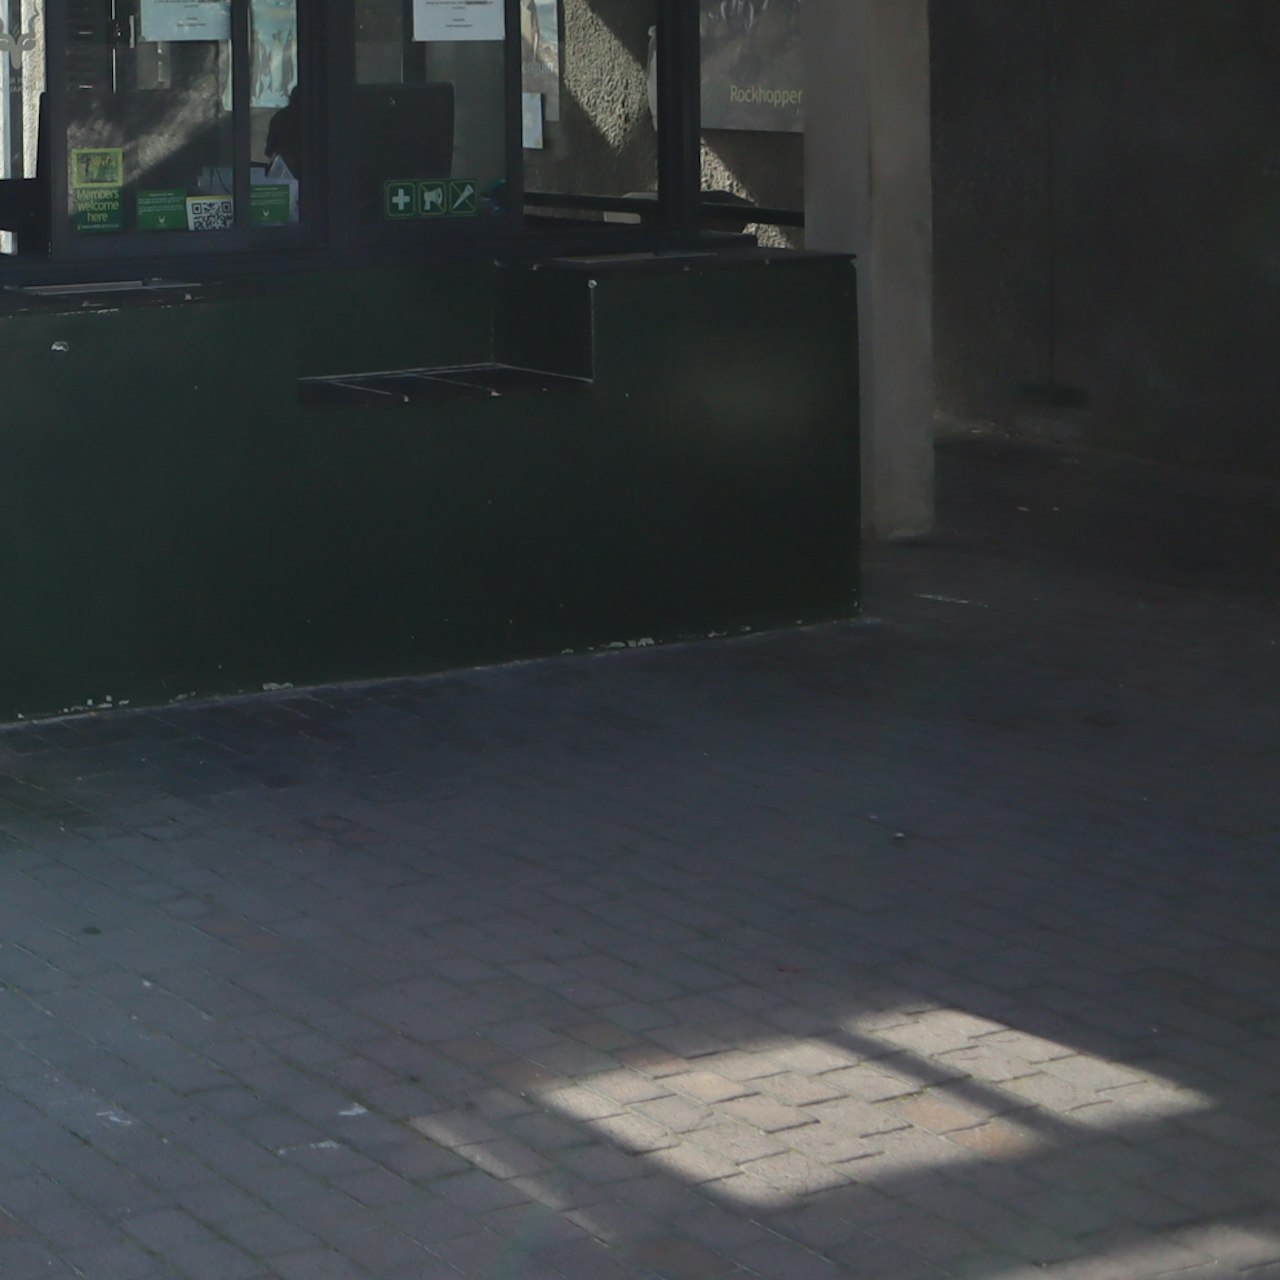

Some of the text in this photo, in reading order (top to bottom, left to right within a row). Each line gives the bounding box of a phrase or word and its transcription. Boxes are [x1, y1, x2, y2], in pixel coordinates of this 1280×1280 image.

[730, 84, 803, 108] Rockhopper
[77, 189, 119, 200] Members
[77, 200, 119, 210] welcome
[88, 213, 108, 222] here
